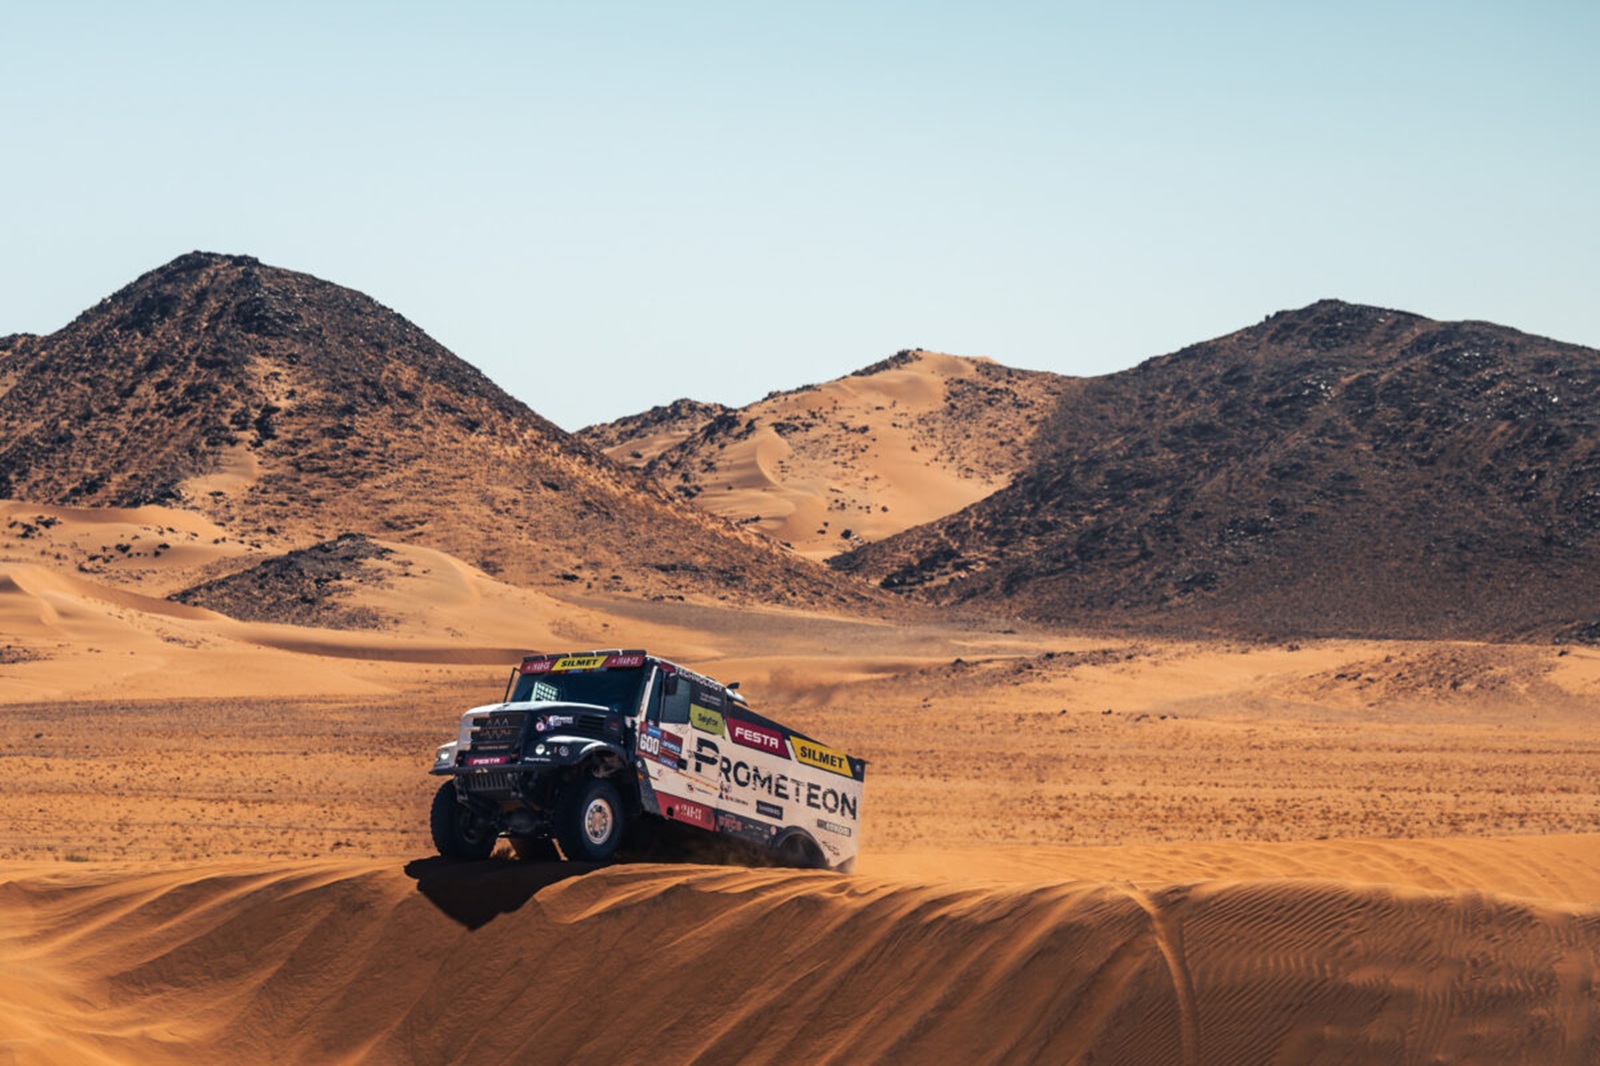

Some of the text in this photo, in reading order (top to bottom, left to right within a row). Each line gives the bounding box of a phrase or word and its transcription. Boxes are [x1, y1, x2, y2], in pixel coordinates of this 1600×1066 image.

[560, 658, 599, 668] SILMET
[640, 733, 660, 755] 600
[734, 727, 779, 749] FESTA
[800, 746, 845, 769] SILMET
[694, 736, 858, 820] PROMETEON
